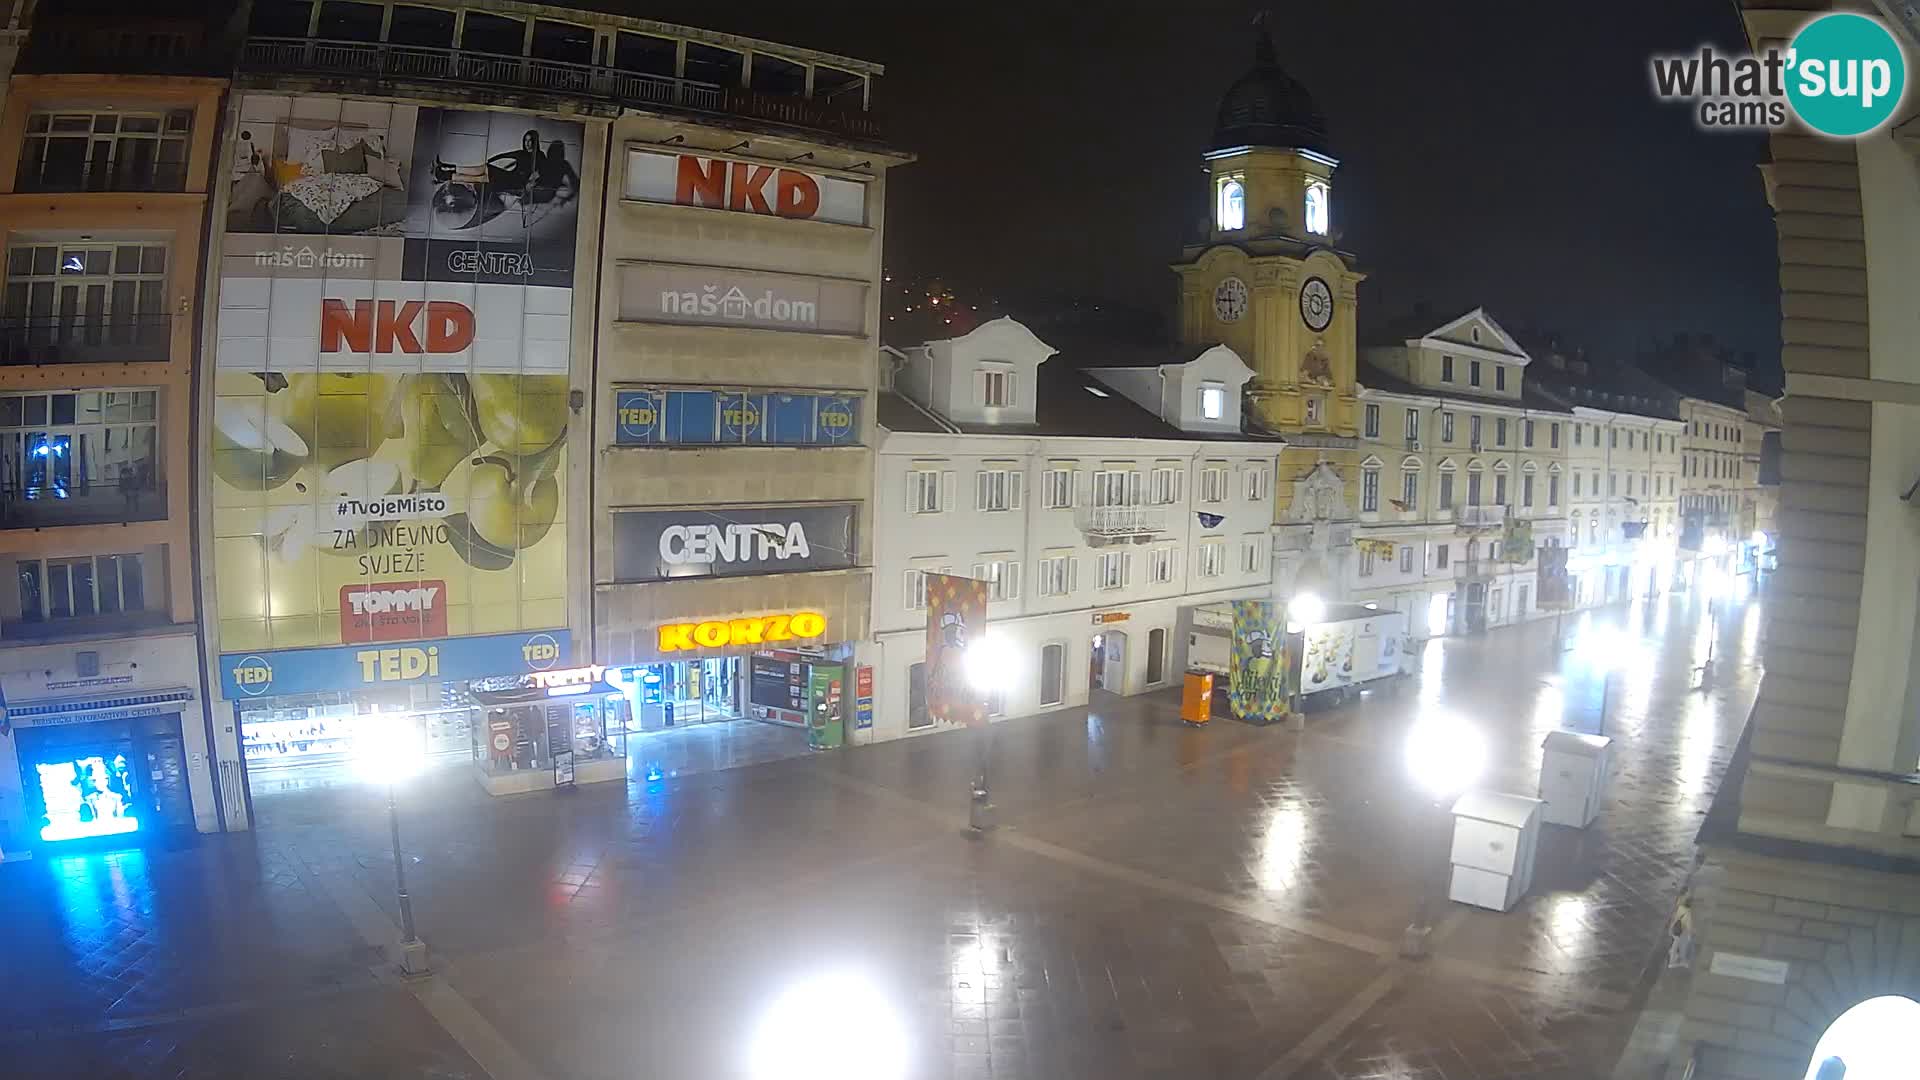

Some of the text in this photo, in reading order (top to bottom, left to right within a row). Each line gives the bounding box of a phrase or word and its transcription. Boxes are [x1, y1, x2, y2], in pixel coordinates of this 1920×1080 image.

[675, 154, 821, 220] NKD
[255, 247, 366, 269] naš dom
[448, 250, 534, 276] CENTRA
[661, 284, 816, 323] naš dom
[320, 297, 477, 354] NKD
[619, 408, 657, 426] TEDi
[723, 409, 759, 426] TEDi
[337, 496, 446, 518] #TvojeMisto
[333, 523, 451, 550] ZA DNEVNO
[659, 521, 810, 565] CENTRA
[359, 547, 426, 576] SVJEŽE
[348, 587, 438, 615] TOMMY
[658, 611, 827, 653] KORZO
[357, 646, 440, 683] TEDi
[523, 642, 560, 661] TEDi
[233, 666, 273, 685] TEDi
